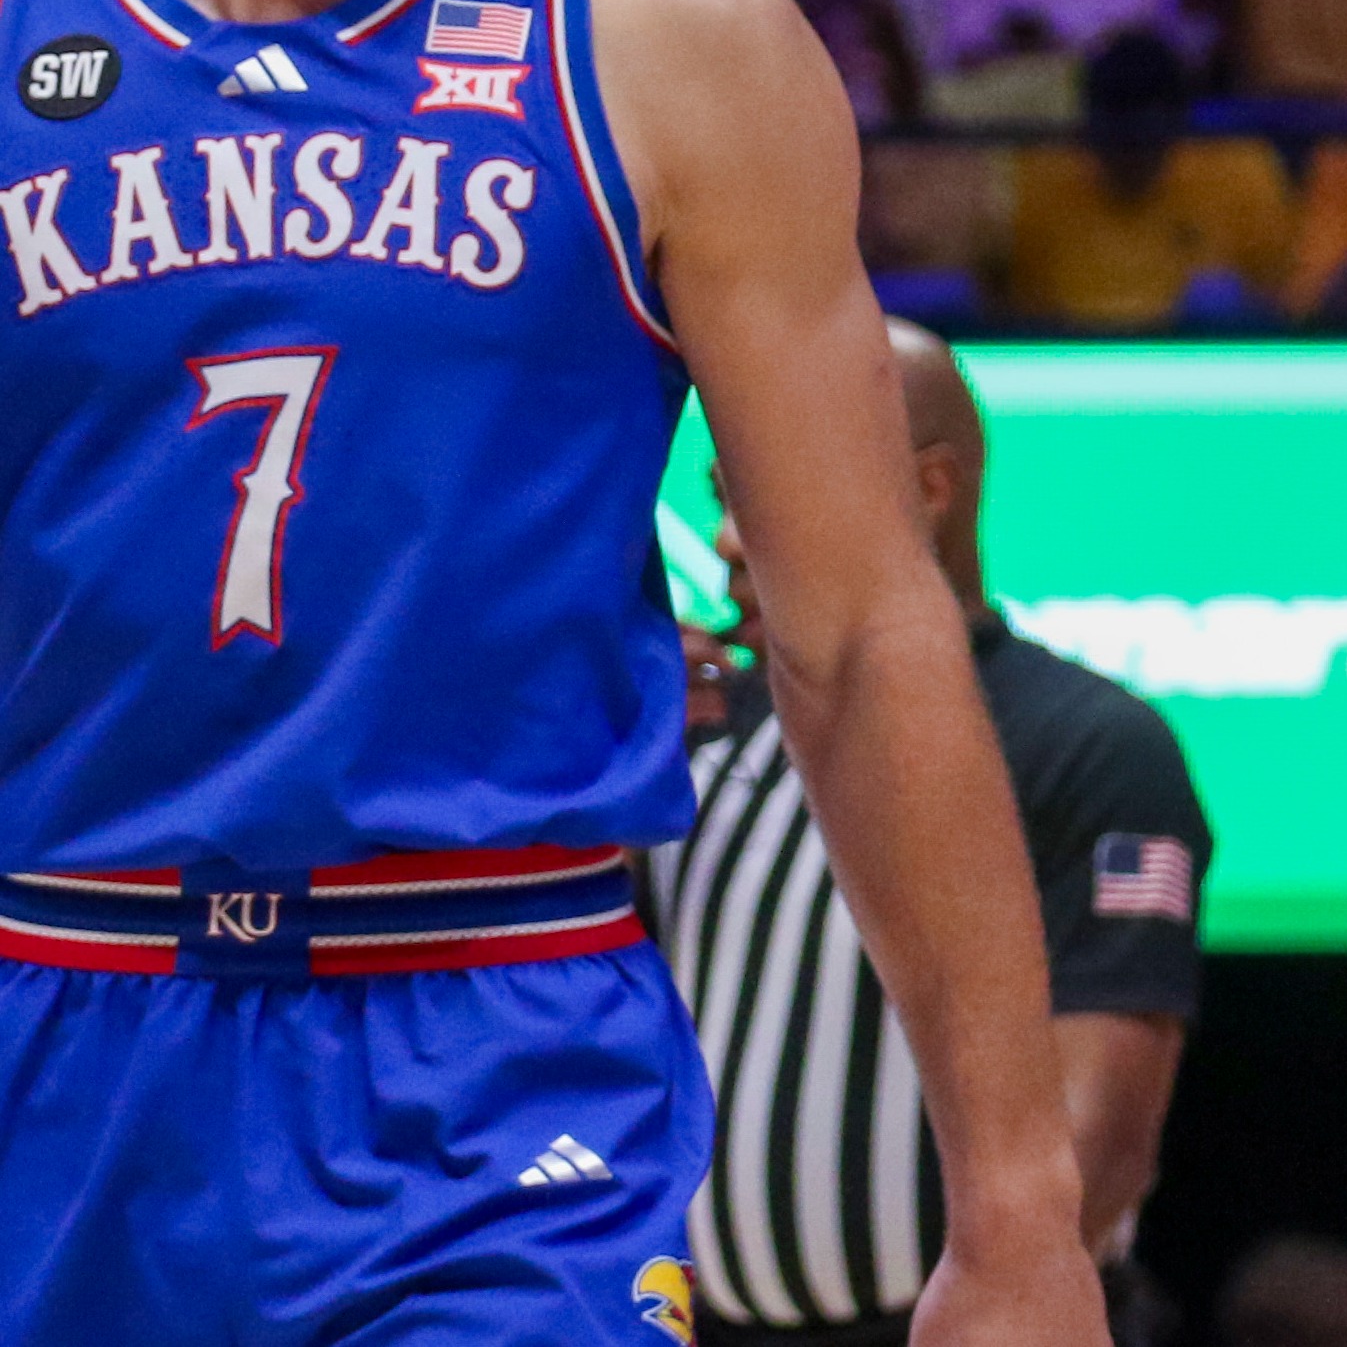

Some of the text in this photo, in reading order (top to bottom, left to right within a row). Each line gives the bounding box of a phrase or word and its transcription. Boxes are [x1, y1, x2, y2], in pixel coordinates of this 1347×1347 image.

[27, 50, 108, 99] SW
[417, 62, 524, 113] XII
[0, 131, 536, 317] KANSAS
[184, 347, 338, 649] 7
[206, 892, 283, 943] KU
